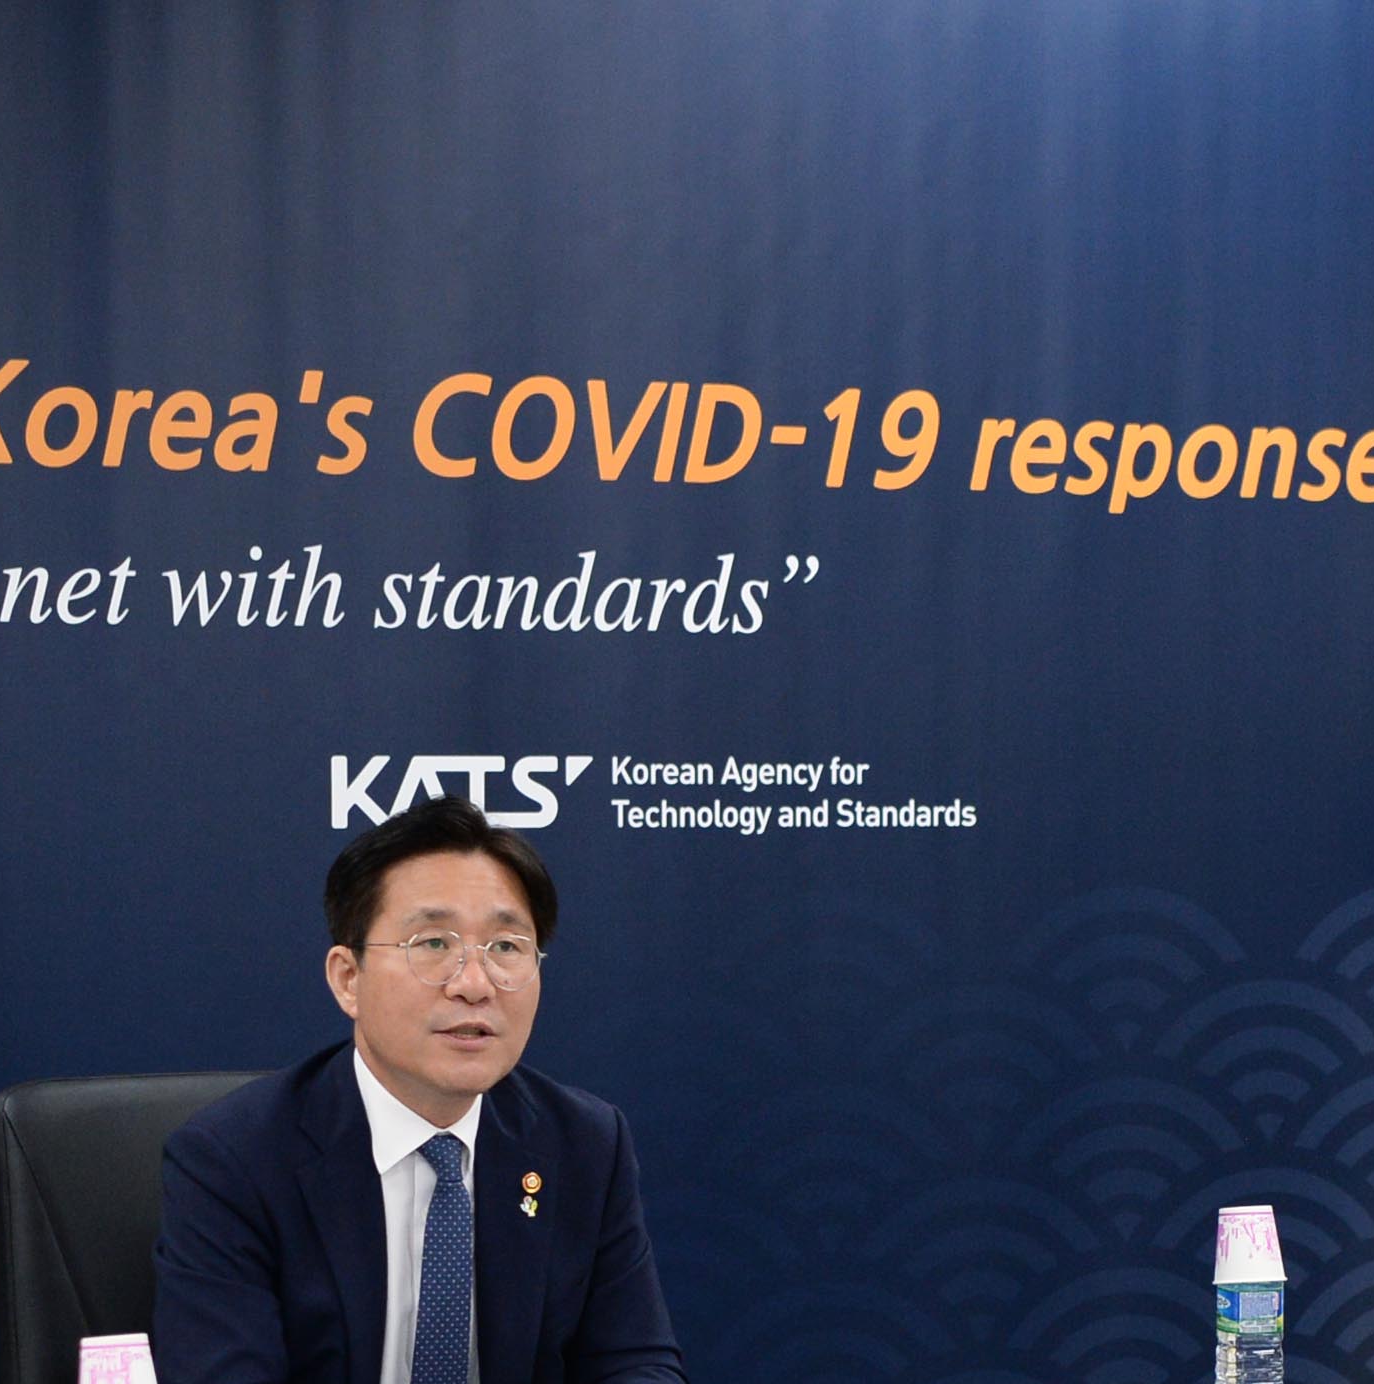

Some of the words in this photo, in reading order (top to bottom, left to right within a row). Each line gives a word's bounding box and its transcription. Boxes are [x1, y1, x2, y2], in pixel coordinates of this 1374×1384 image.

[414, 373, 939, 490] COVID-19
[162, 545, 344, 628] with
[612, 756, 713, 784] Korean
[721, 756, 823, 792] Agency
[830, 757, 869, 785] for
[611, 799, 772, 835] Technology
[778, 799, 828, 827] and
[837, 799, 976, 827] Standards
